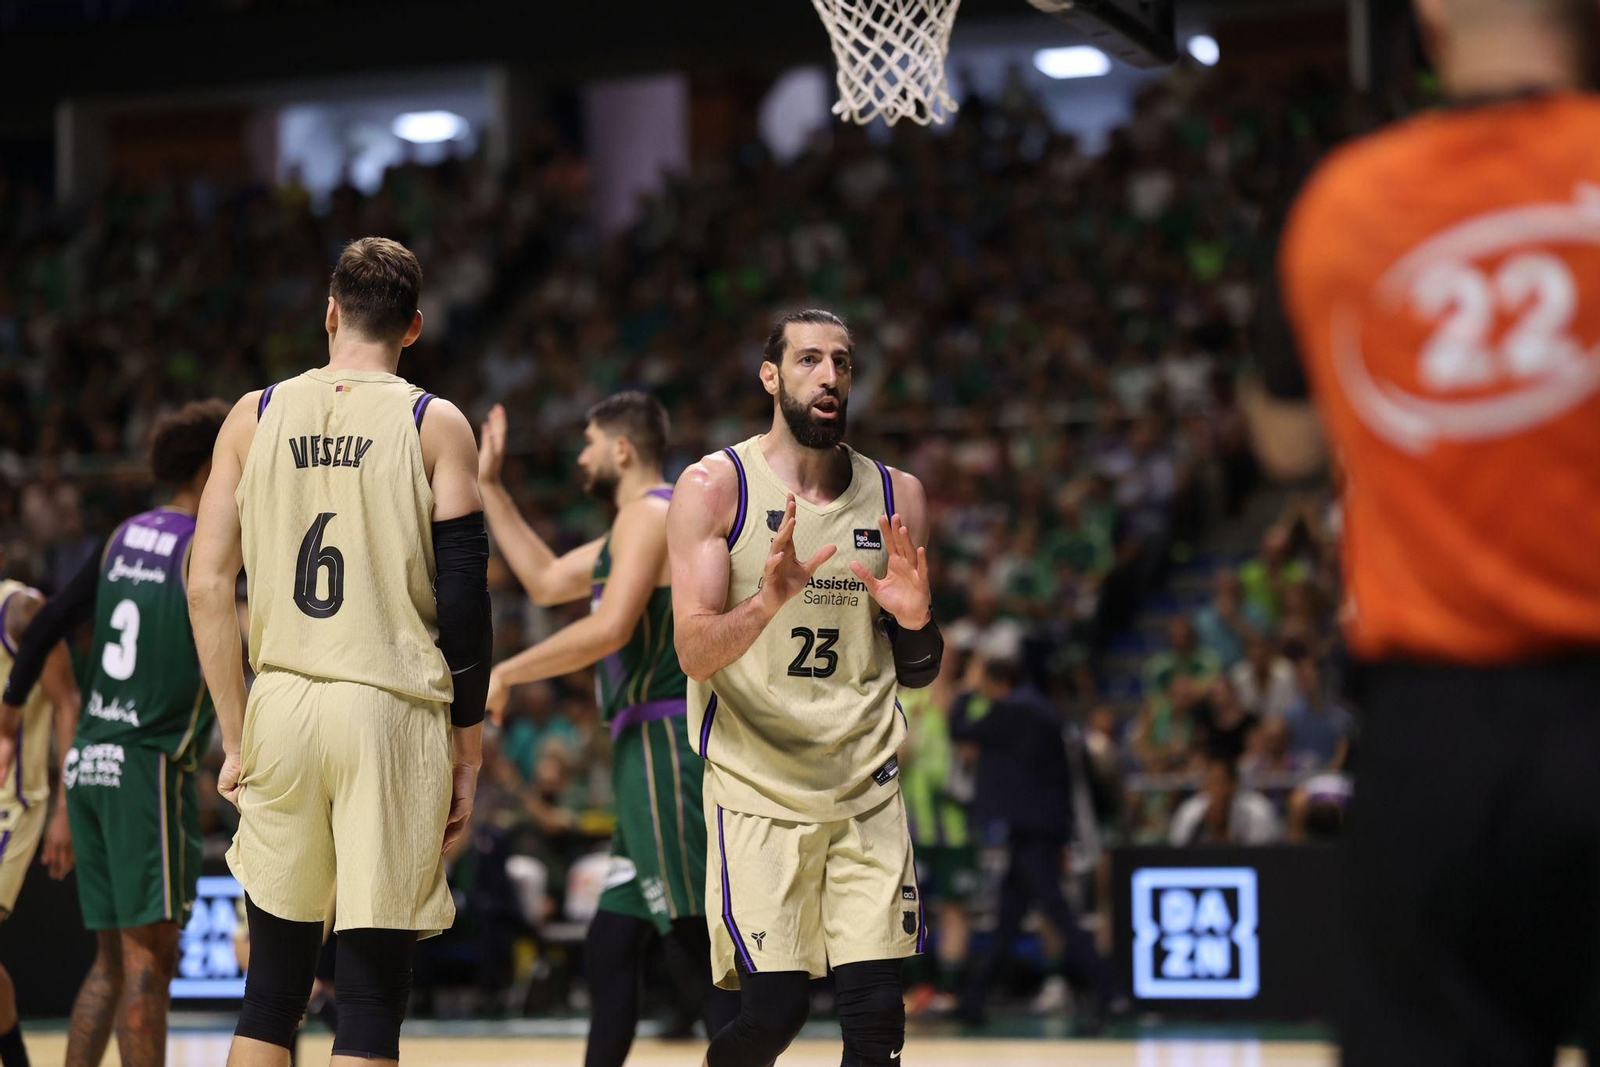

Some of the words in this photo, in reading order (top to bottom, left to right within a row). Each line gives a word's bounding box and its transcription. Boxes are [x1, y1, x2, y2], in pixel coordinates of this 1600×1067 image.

[1411, 253, 1588, 390] 22
[289, 434, 374, 469] VESELY
[856, 534, 868, 542] liga
[293, 512, 345, 619] 6
[803, 590, 859, 607] Sanitària
[102, 599, 140, 681] 3
[787, 626, 840, 678] 23
[1159, 887, 1232, 935] DA
[1160, 934, 1231, 979] ZN
